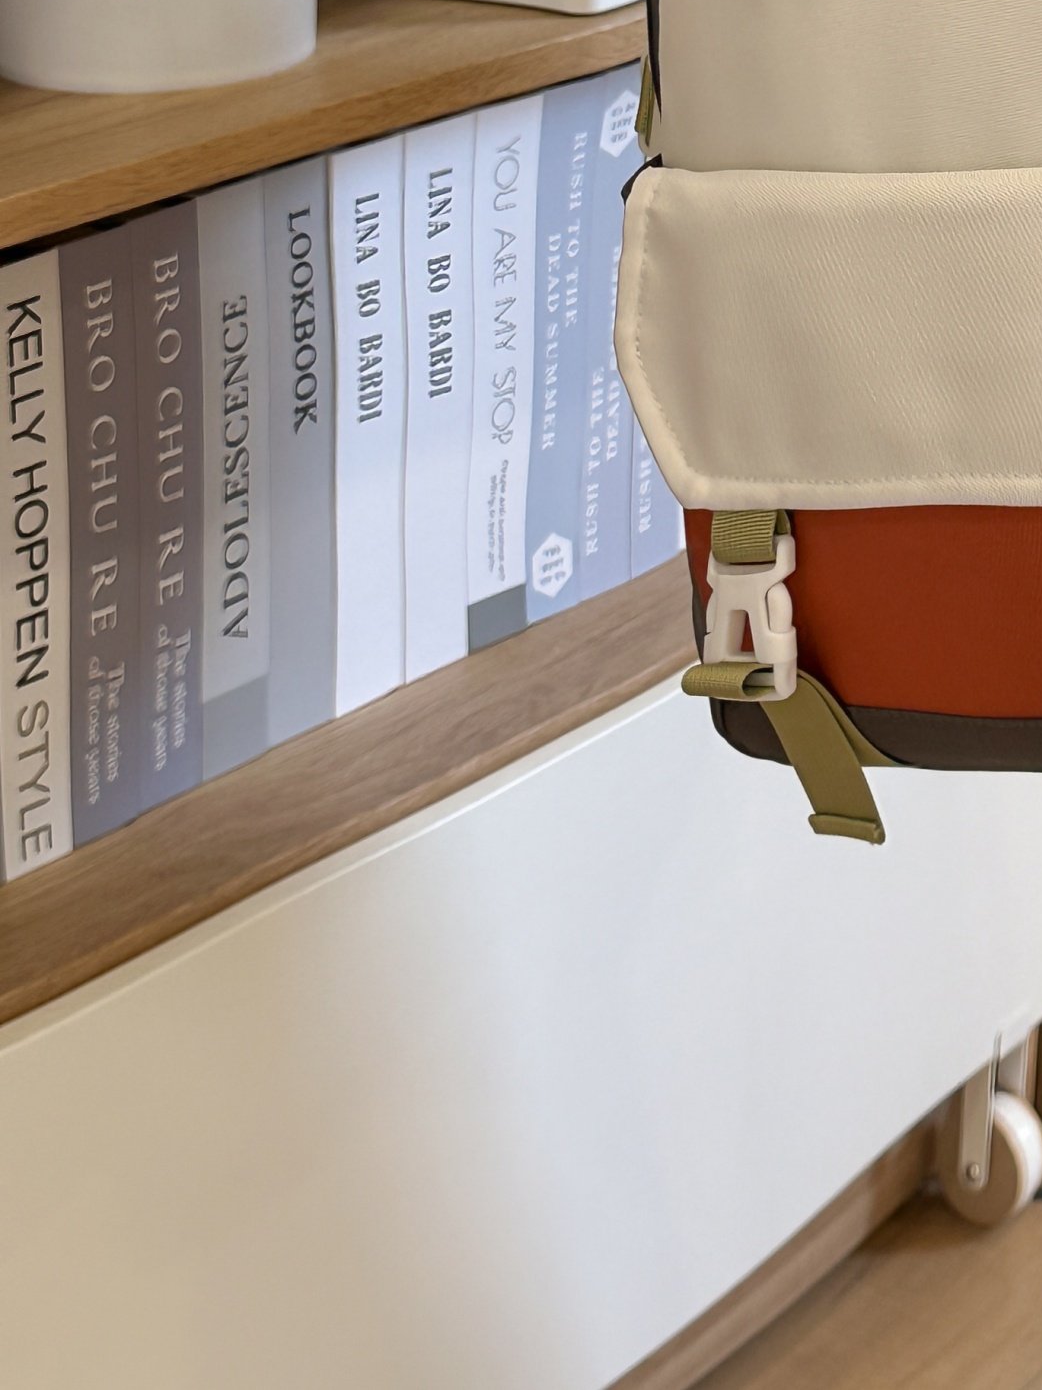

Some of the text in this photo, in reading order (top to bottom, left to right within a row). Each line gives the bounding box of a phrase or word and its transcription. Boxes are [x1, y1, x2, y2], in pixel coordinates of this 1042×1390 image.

[493, 135, 521, 212] YOU
[493, 228, 517, 287] ARE
[565, 131, 588, 328] RUSH TO THE
[355, 192, 383, 424] LINA BO BARDI
[427, 167, 453, 399] LINA BO BARDI
[547, 233, 561, 313] DEAD
[288, 206, 317, 435] LOOKBOOK
[494, 296, 517, 351] MY
[153, 253, 185, 606] BRO CHU RE
[491, 366, 517, 445] STOP
[590, 366, 605, 430] THE
[86, 278, 118, 636] BRO CHU RE
[221, 294, 250, 638] ADOLESCENCE
[587, 436, 601, 477] TO
[7, 295, 53, 862] KELLY HOPPEN STYLE
[107, 660, 125, 710] The
[174, 627, 191, 676] The
